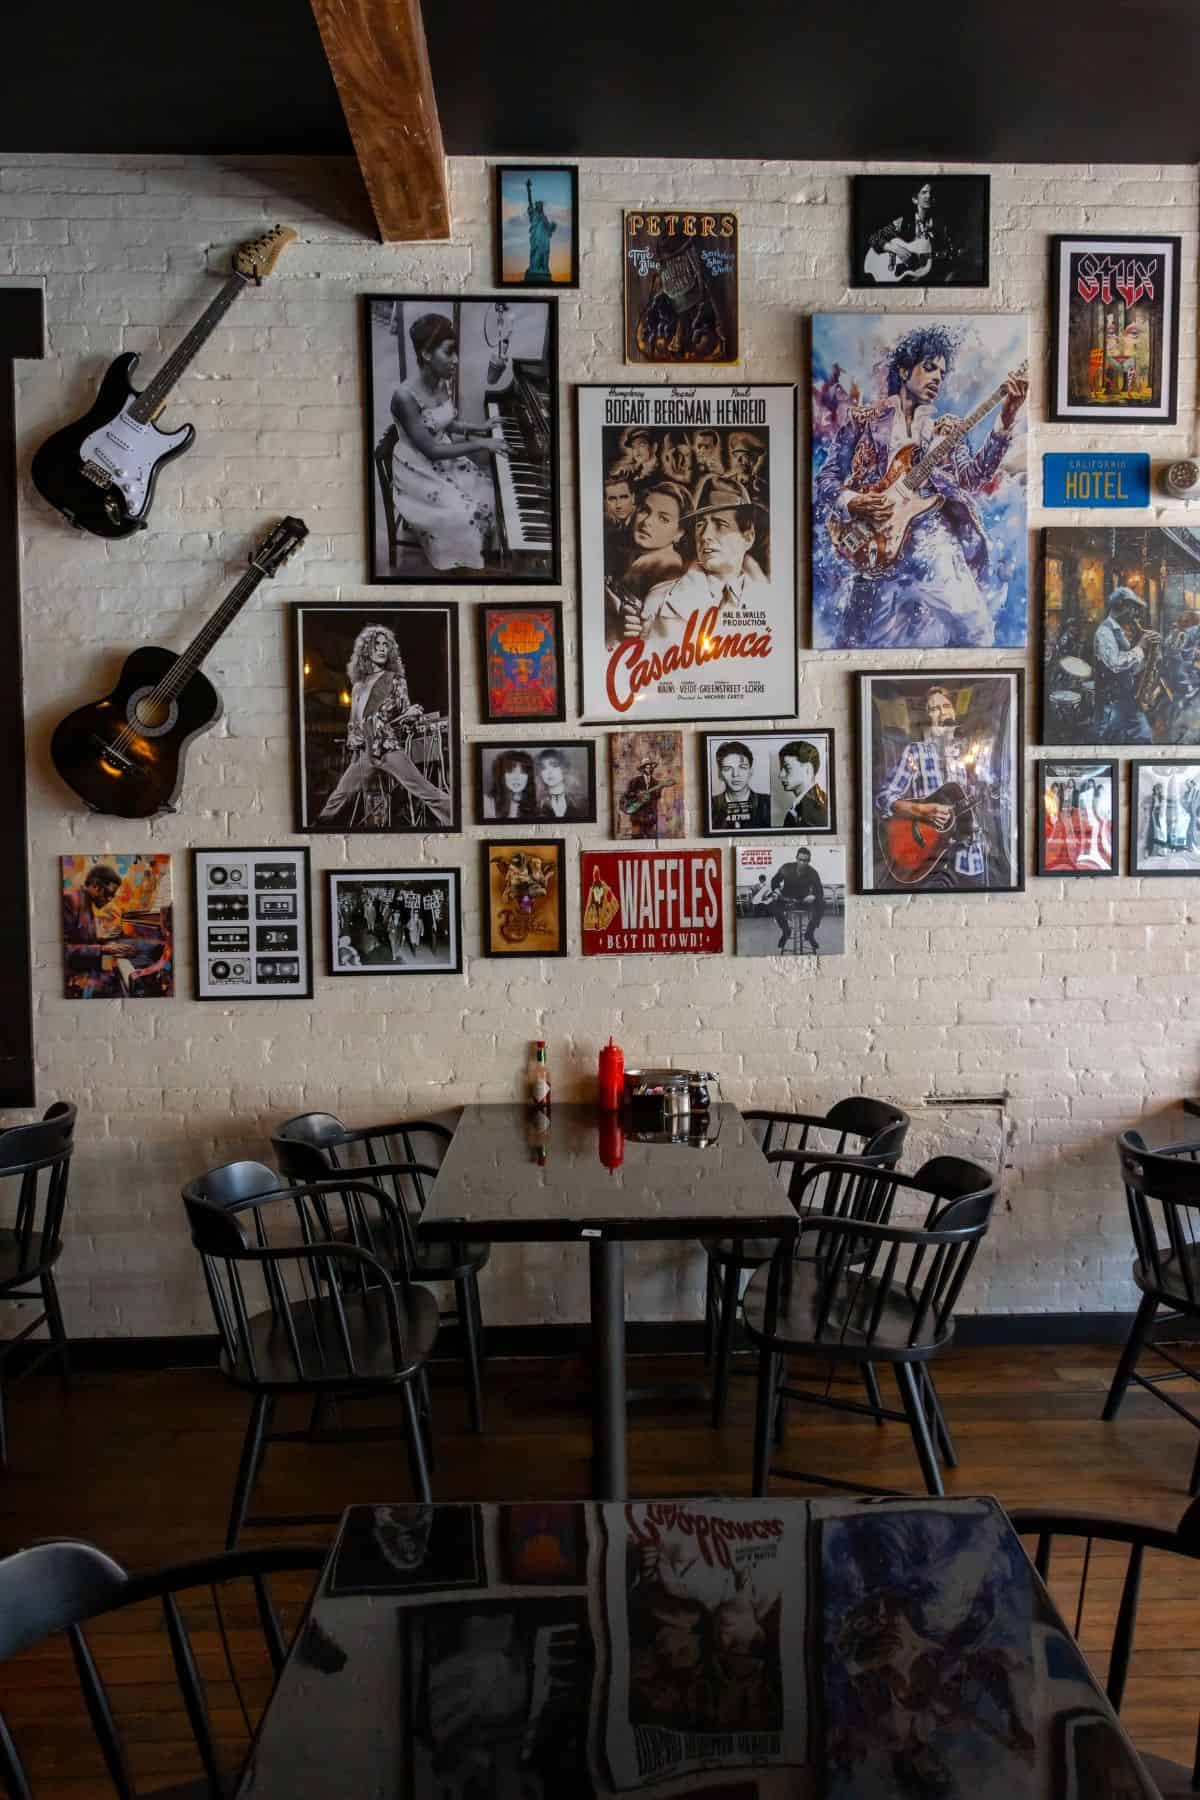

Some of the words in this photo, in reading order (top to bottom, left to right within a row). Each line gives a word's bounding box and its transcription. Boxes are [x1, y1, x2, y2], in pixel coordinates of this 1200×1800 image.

[629, 215, 734, 237] PETERS
[605, 400, 650, 424] BOGART
[655, 400, 711, 424] BERGMAN
[716, 400, 766, 424] HENREID
[1065, 472, 1128, 499] HOTEL
[618, 857, 718, 929] WAFFLES
[607, 934, 638, 949] BEST
